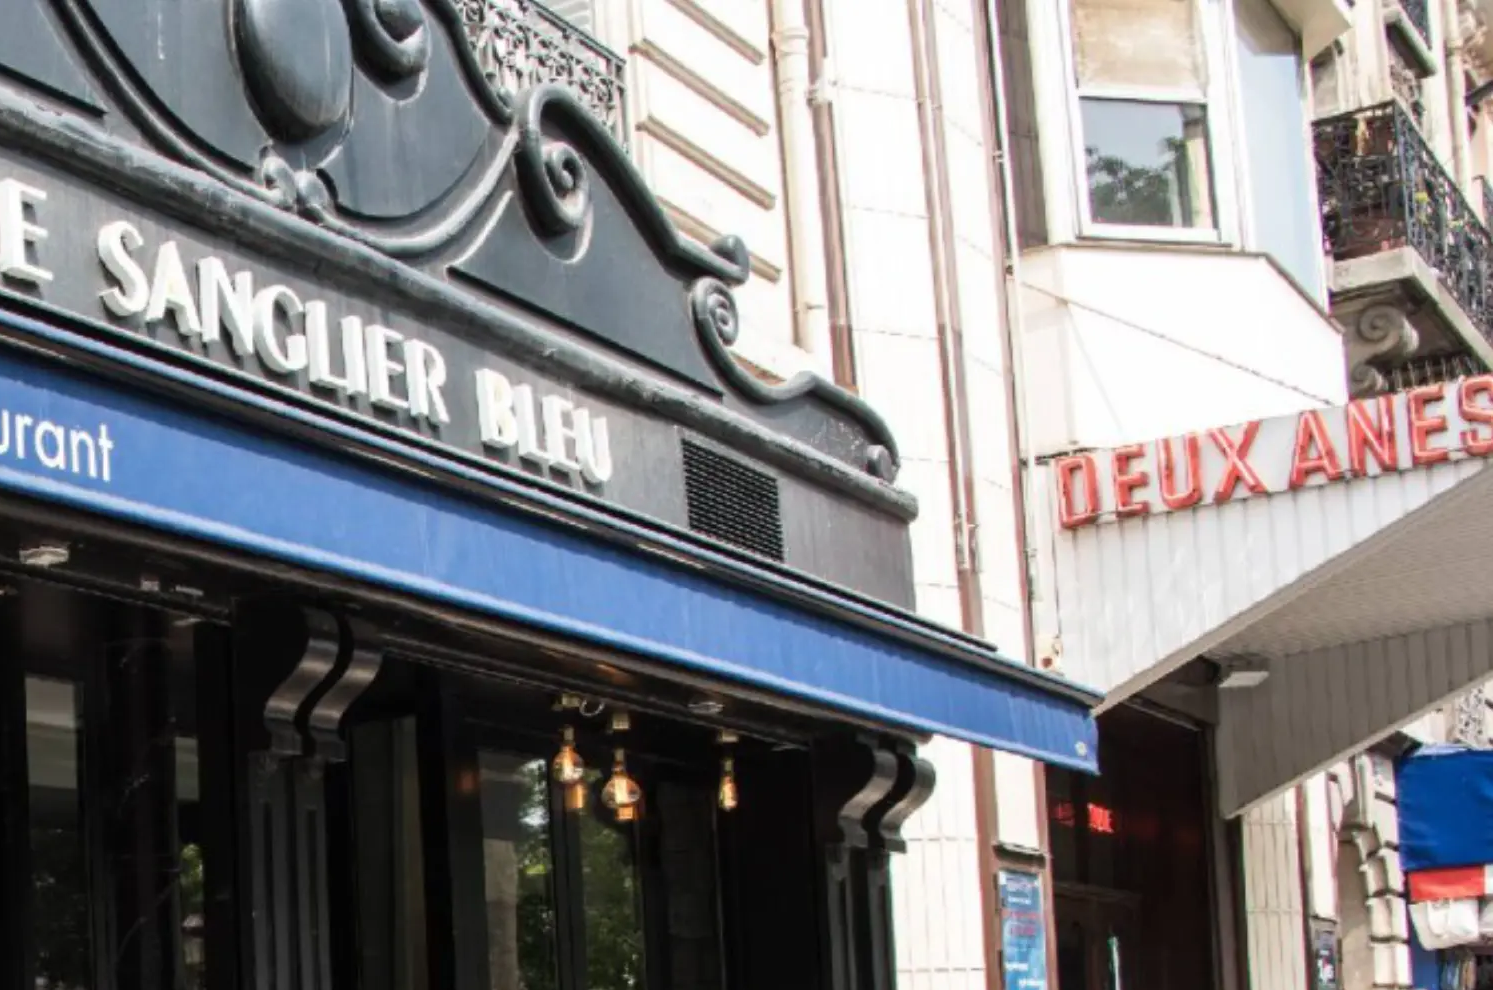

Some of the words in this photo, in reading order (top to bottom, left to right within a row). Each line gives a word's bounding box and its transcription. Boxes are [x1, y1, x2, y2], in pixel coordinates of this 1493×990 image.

[97, 220, 451, 426] SANGLIER
[475, 366, 611, 482] BLEU
[1055, 420, 1269, 530] DEUX
[1289, 372, 1493, 491] ANES
